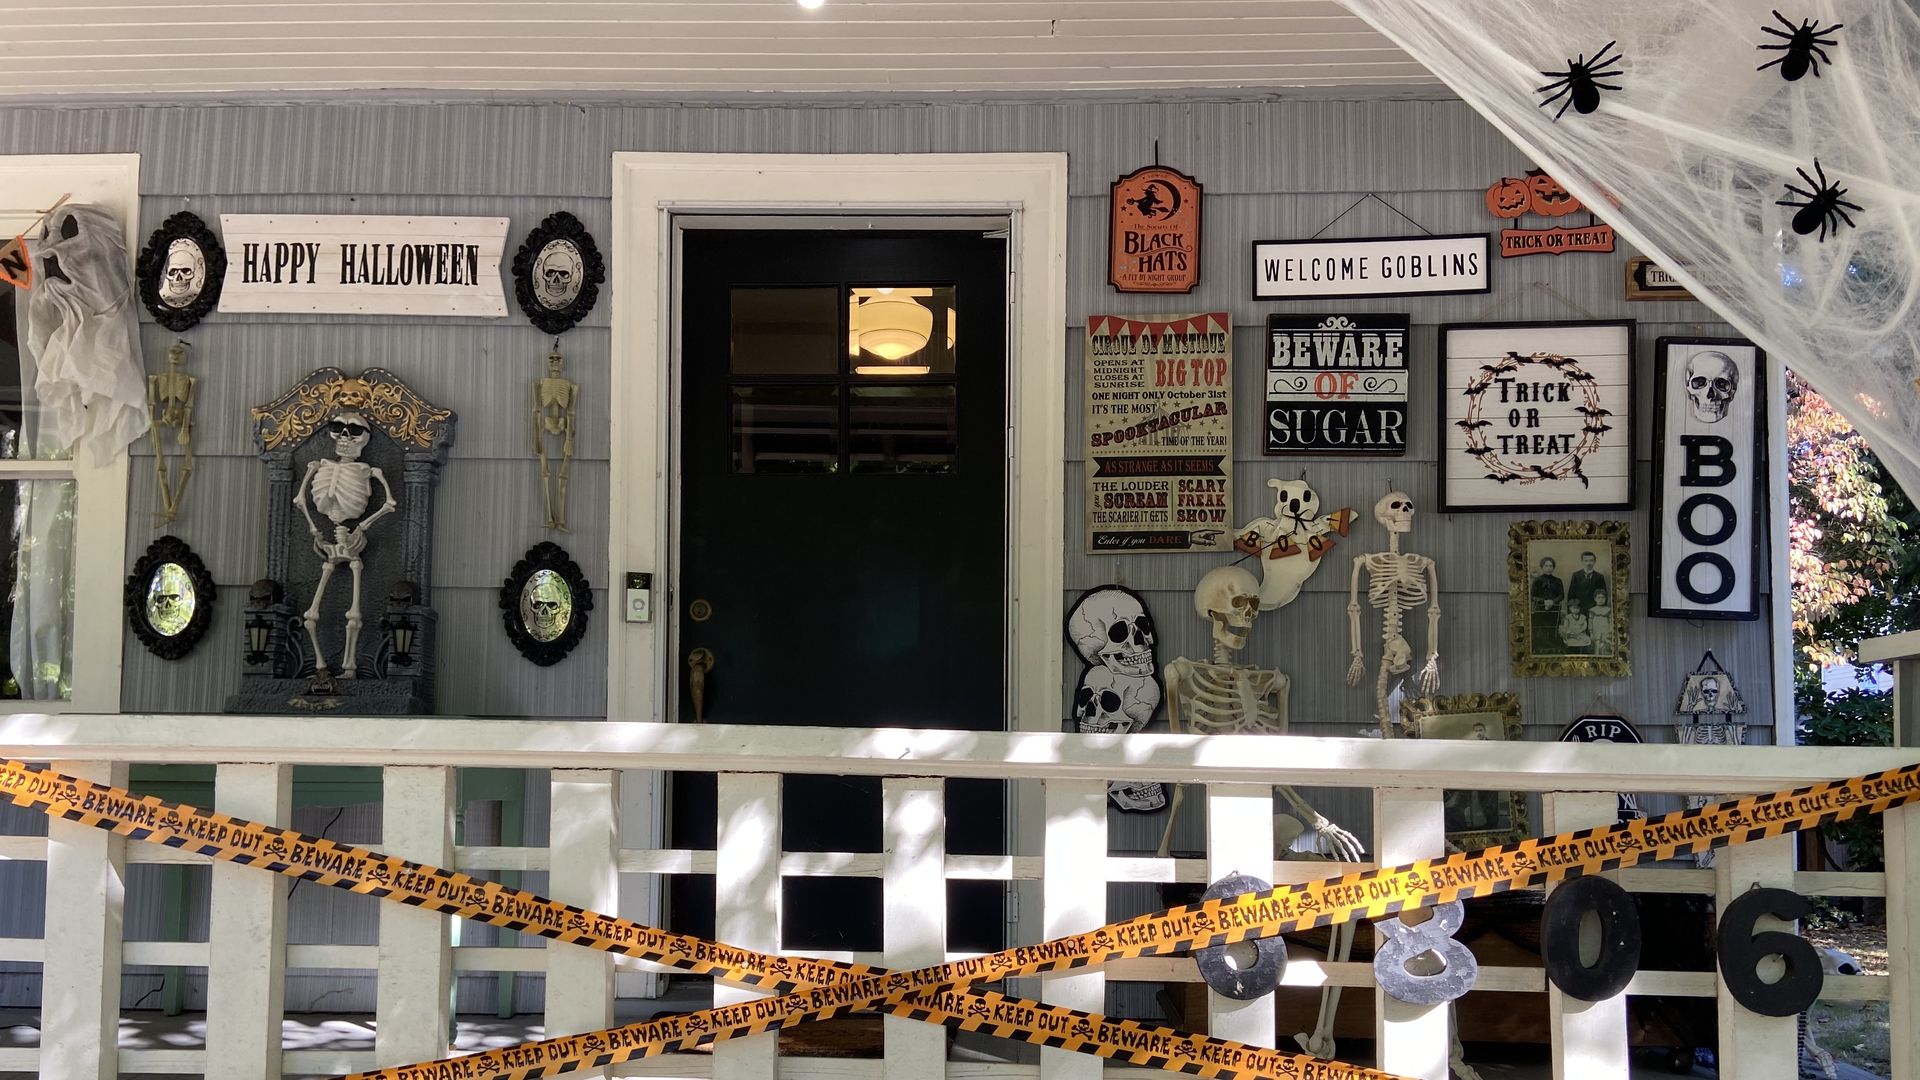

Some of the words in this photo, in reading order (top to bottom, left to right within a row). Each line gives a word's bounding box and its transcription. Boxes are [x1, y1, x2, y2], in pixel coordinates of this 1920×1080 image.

[1124, 231, 1184, 254] BLACK
[1505, 233, 1543, 249] TRICK
[1546, 234, 1564, 248] OR
[1566, 232, 1608, 248] TREAT
[0, 250, 27, 279] N
[242, 242, 320, 284] HAPPY
[340, 243, 479, 286] HALLOWEEN
[1138, 251, 1187, 272] HATS
[1264, 257, 1369, 282] WELCOME
[1381, 253, 1478, 279] GOBLINS
[1092, 335, 1136, 356] CIRQUE
[1142, 334, 1158, 355] DE
[1162, 333, 1226, 354] MYSTIQUE
[1272, 333, 1403, 367] BEWARE
[1155, 358, 1188, 388] BIG
[1190, 358, 1227, 387] TOP
[1092, 392, 1110, 401] ONE
[1112, 391, 1140, 400] NIGHT
[1142, 391, 1166, 400] ONLY
[1168, 390, 1206, 399] October
[1208, 390, 1227, 398] 31st
[1314, 371, 1359, 400] OF
[1495, 377, 1572, 403] TRICK
[1092, 404, 1108, 414] IT'S
[1110, 404, 1129, 414] THE
[1131, 403, 1158, 414] MOST
[1508, 408, 1540, 428] OR
[1091, 401, 1228, 447] SPOOKTACULAR
[1270, 408, 1405, 444] SUGAR
[1161, 436, 1180, 446] TIME
[1180, 436, 1190, 446] OF
[1191, 436, 1205, 446] THE
[1206, 435, 1227, 446] YEAR!
[1497, 433, 1575, 455] TREAT
[1104, 461, 1117, 473] AS
[1118, 460, 1159, 473] STRANGE
[1160, 460, 1173, 472] AS
[1174, 460, 1183, 472] IT
[1185, 459, 1214, 472] SEEMS
[1093, 482, 1118, 492] THE
[1121, 481, 1169, 492] LOUDER
[1178, 479, 1226, 493] SCARY
[1104, 492, 1168, 509] SCREAM
[1178, 494, 1226, 508] FREAK
[1093, 512, 1107, 523] THE
[1108, 511, 1139, 523] SCARIER
[1140, 511, 1148, 522] IT
[1150, 510, 1168, 522] GETS
[1177, 508, 1227, 523] SHOW
[1676, 434, 1737, 604] BOO
[1098, 535, 1120, 546] Enter
[1122, 536, 1130, 546] if
[1131, 537, 1146, 547] you
[1150, 536, 1182, 544] DARE
[1585, 724, 1621, 738] RIP
[0, 767, 25, 789] EEP
[27, 777, 60, 798] OUT
[82, 790, 158, 827] BEWARE
[184, 818, 228, 843] KEEP
[230, 828, 263, 852] OUT
[289, 843, 364, 879] BEWARE
[392, 871, 434, 896] KEEP
[438, 880, 470, 904] OUT
[492, 895, 564, 929] BEWARE
[592, 920, 634, 943] KEEP
[637, 928, 668, 950] OUT
[695, 942, 766, 973] BEWARE
[795, 963, 835, 985] KEEP
[993, 1004, 1034, 1029] KEEP
[1038, 1011, 1070, 1034] OUT
[1098, 1024, 1170, 1056] BEWARE
[1200, 1045, 1244, 1068] KEEP
[1246, 1052, 1278, 1074] OUT
[502, 1046, 545, 1070] KEEP
[550, 1040, 579, 1062] OUT
[609, 1020, 682, 1050] BEWARE
[710, 1003, 752, 1028] KEEP
[755, 998, 786, 1021] OUT
[811, 977, 884, 1008] BEWARE
[912, 964, 952, 987] KEEP
[957, 957, 986, 977] OUT
[1015, 935, 1088, 966] BEWARE
[1117, 923, 1160, 948] KEEP
[1162, 918, 1194, 940] OUT
[1218, 897, 1294, 930] BEWARE
[1322, 884, 1364, 910] KEEP
[1369, 877, 1400, 899] OUT
[1430, 857, 1509, 891] BEWARE
[1537, 844, 1582, 868] KEEP
[1584, 836, 1617, 857] OUT
[1643, 815, 1722, 848] BEWARE
[1750, 801, 1792, 824] KEEP
[1799, 792, 1831, 814] OUT
[1862, 771, 1920, 800] BEWA
